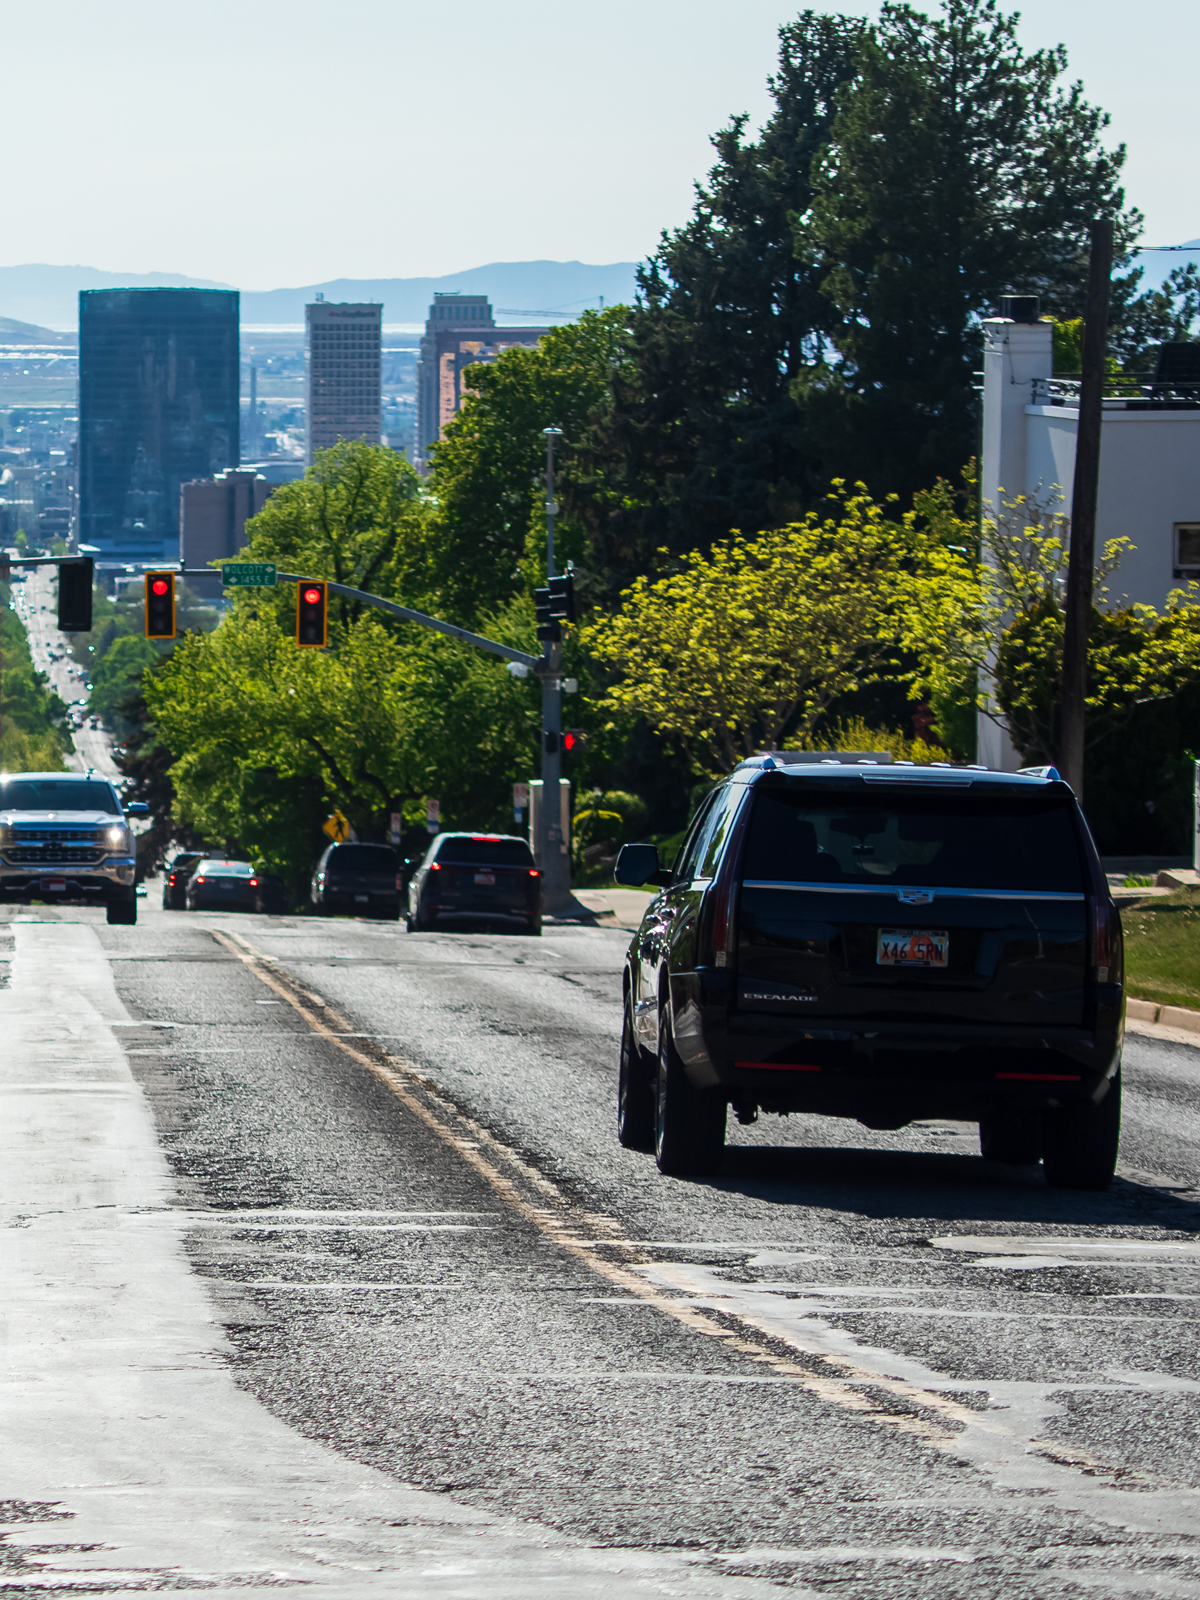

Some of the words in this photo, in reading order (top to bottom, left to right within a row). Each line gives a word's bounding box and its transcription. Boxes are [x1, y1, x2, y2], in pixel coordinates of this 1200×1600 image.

[224, 565, 263, 574] WOLCOTT
[241, 575, 261, 584] 1455
[264, 575, 270, 584] E
[882, 942, 907, 959] X46
[917, 943, 943, 961] 5RN
[743, 993, 818, 1002] ESCALADE
